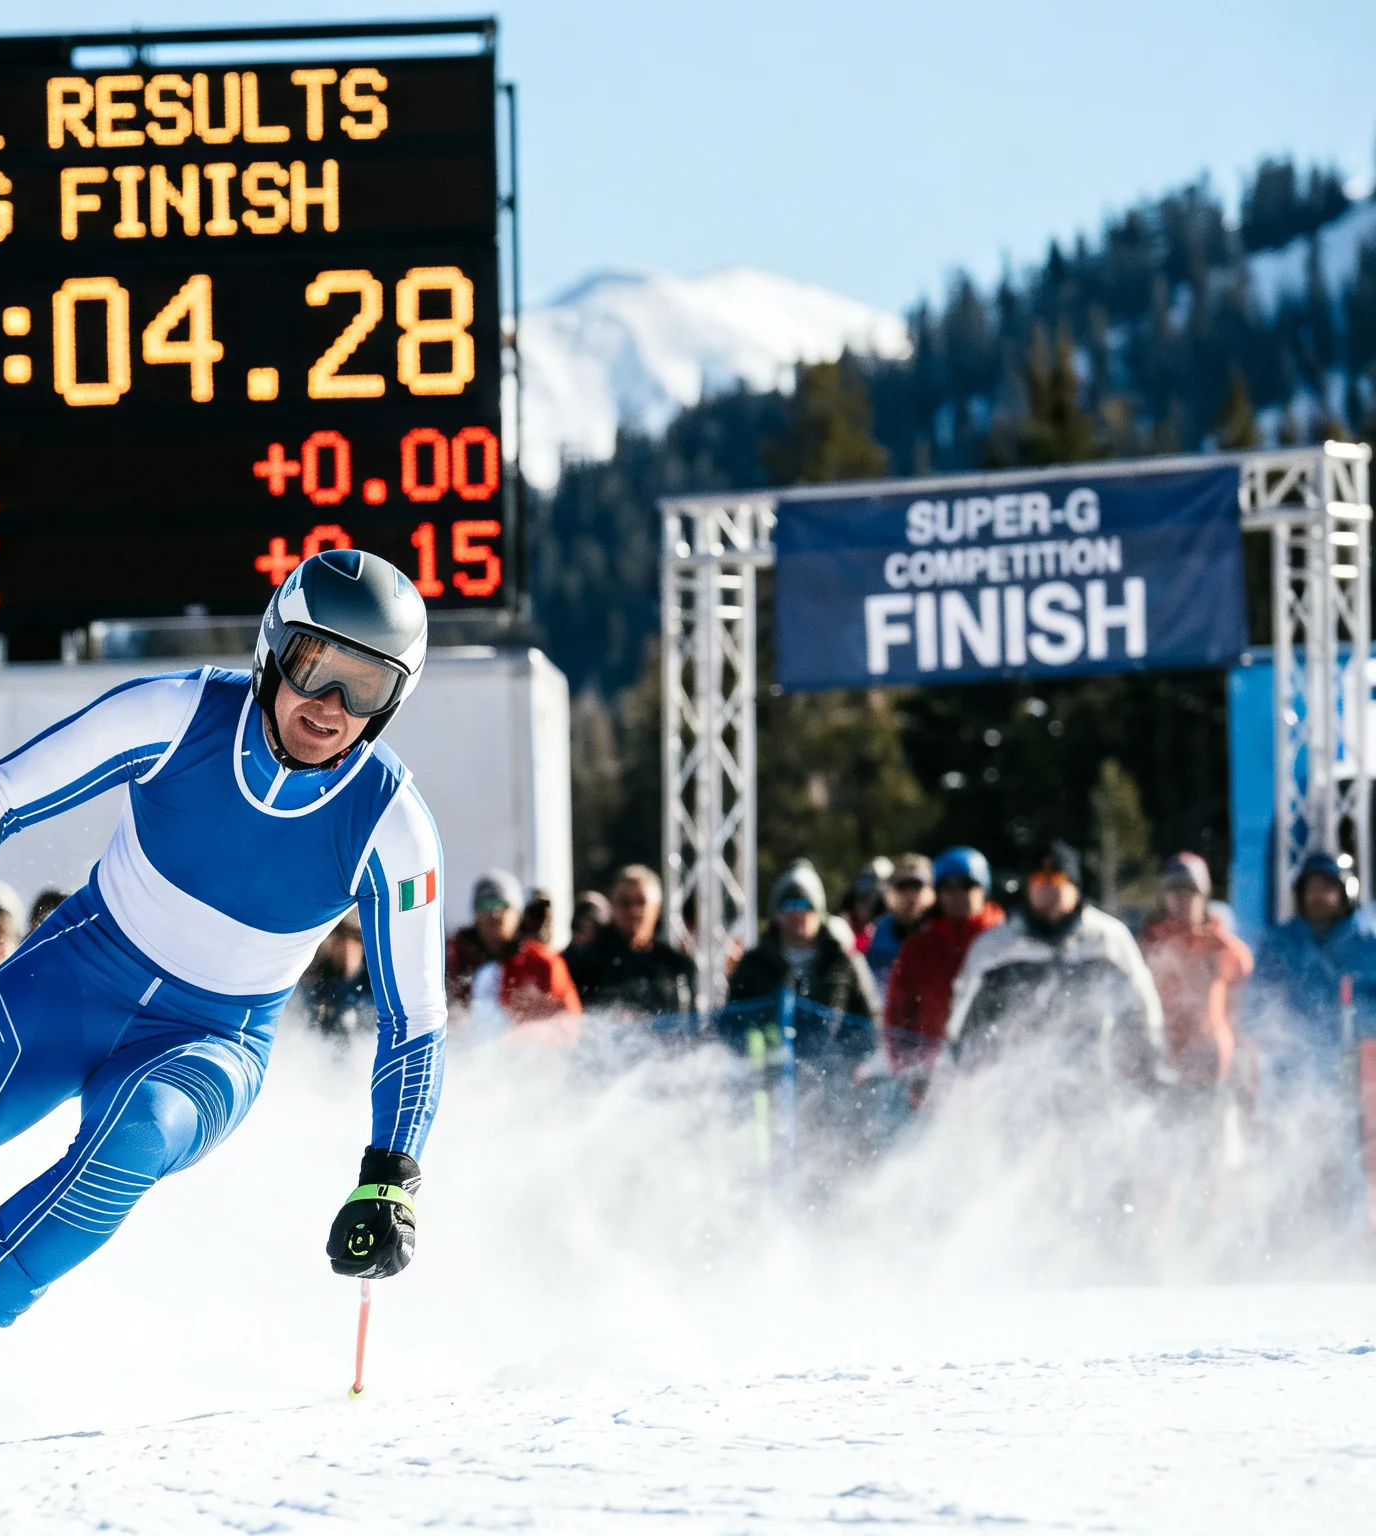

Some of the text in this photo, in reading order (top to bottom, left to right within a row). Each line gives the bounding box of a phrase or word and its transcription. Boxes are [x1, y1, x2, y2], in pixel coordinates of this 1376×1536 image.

[47, 67, 388, 149] RESULTS
[61, 159, 339, 240] FINISH
[253, 427, 499, 505] +0.00
[905, 487, 1100, 545] SUPER-G
[885, 534, 1121, 589] COMPETITION
[865, 576, 1146, 674] FINISH
